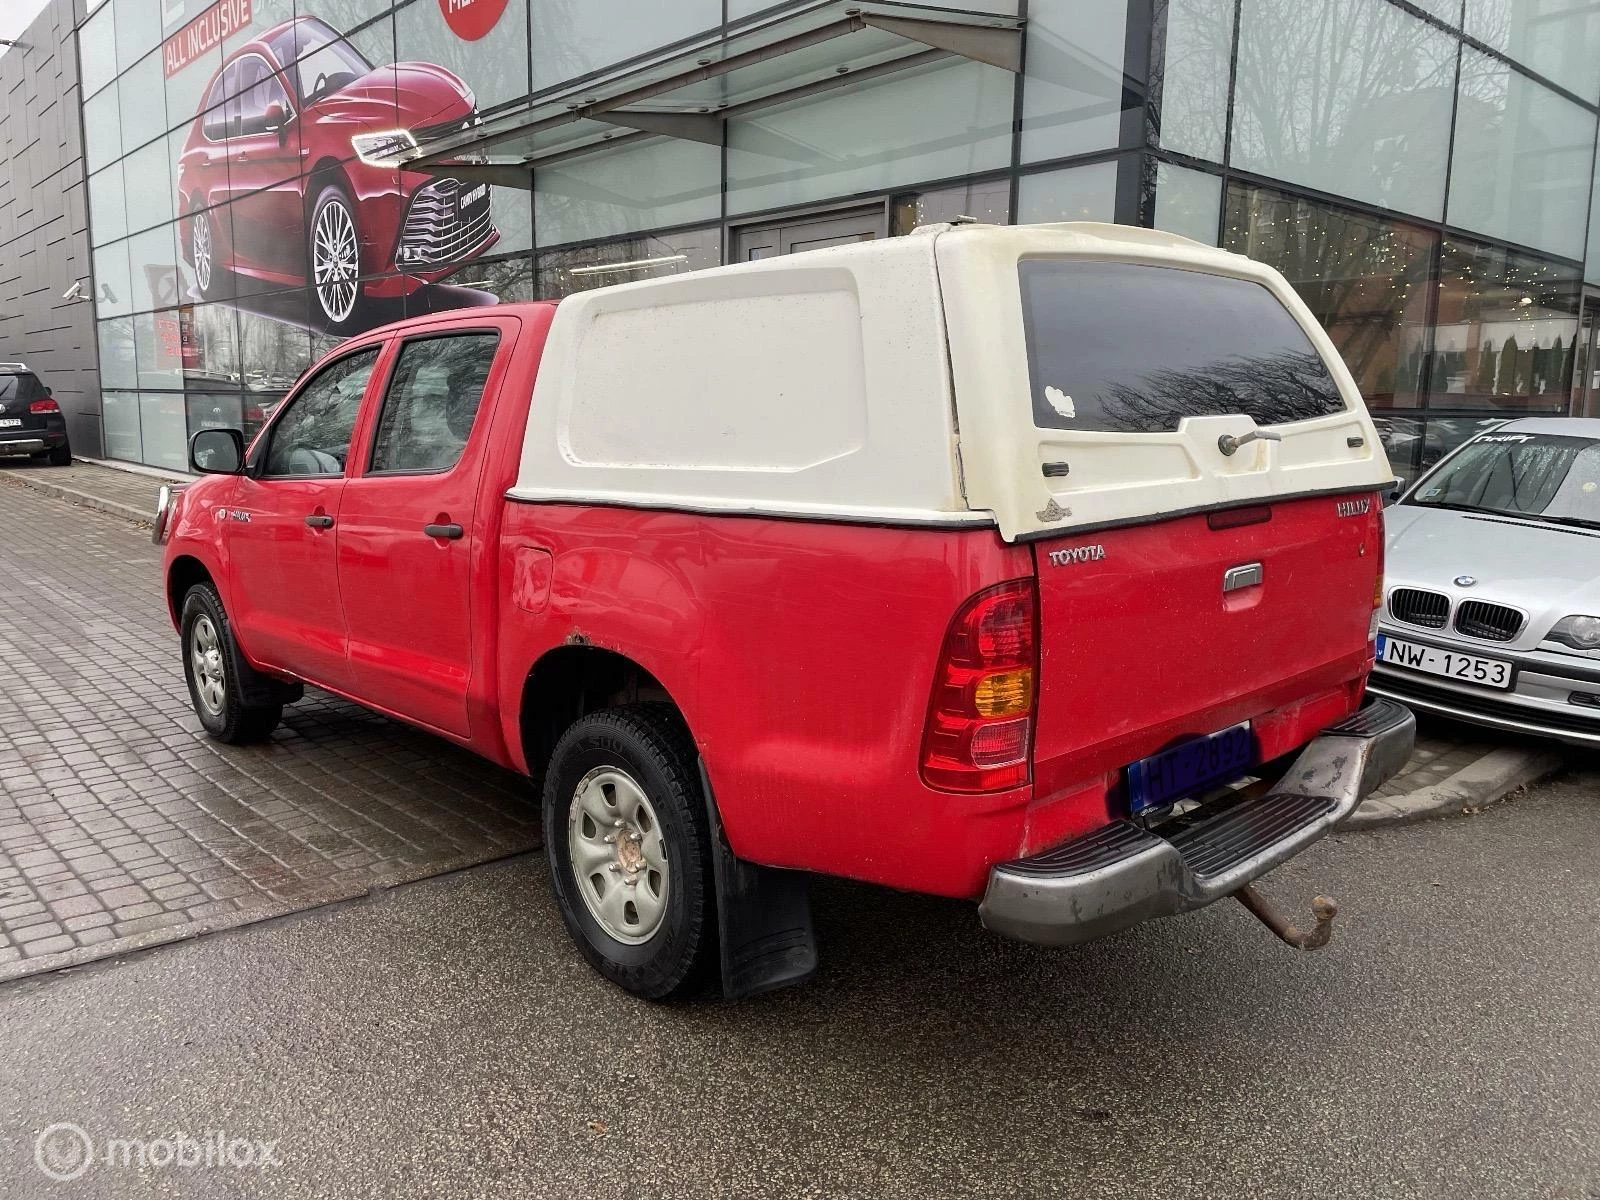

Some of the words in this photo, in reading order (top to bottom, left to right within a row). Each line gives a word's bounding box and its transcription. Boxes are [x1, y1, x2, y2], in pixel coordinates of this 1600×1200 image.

[166, 34, 186, 74] ALL
[187, 0, 250, 59] INCLUSIVE
[1337, 499, 1370, 518] HILUX
[1049, 544, 1106, 567] TOYOTA
